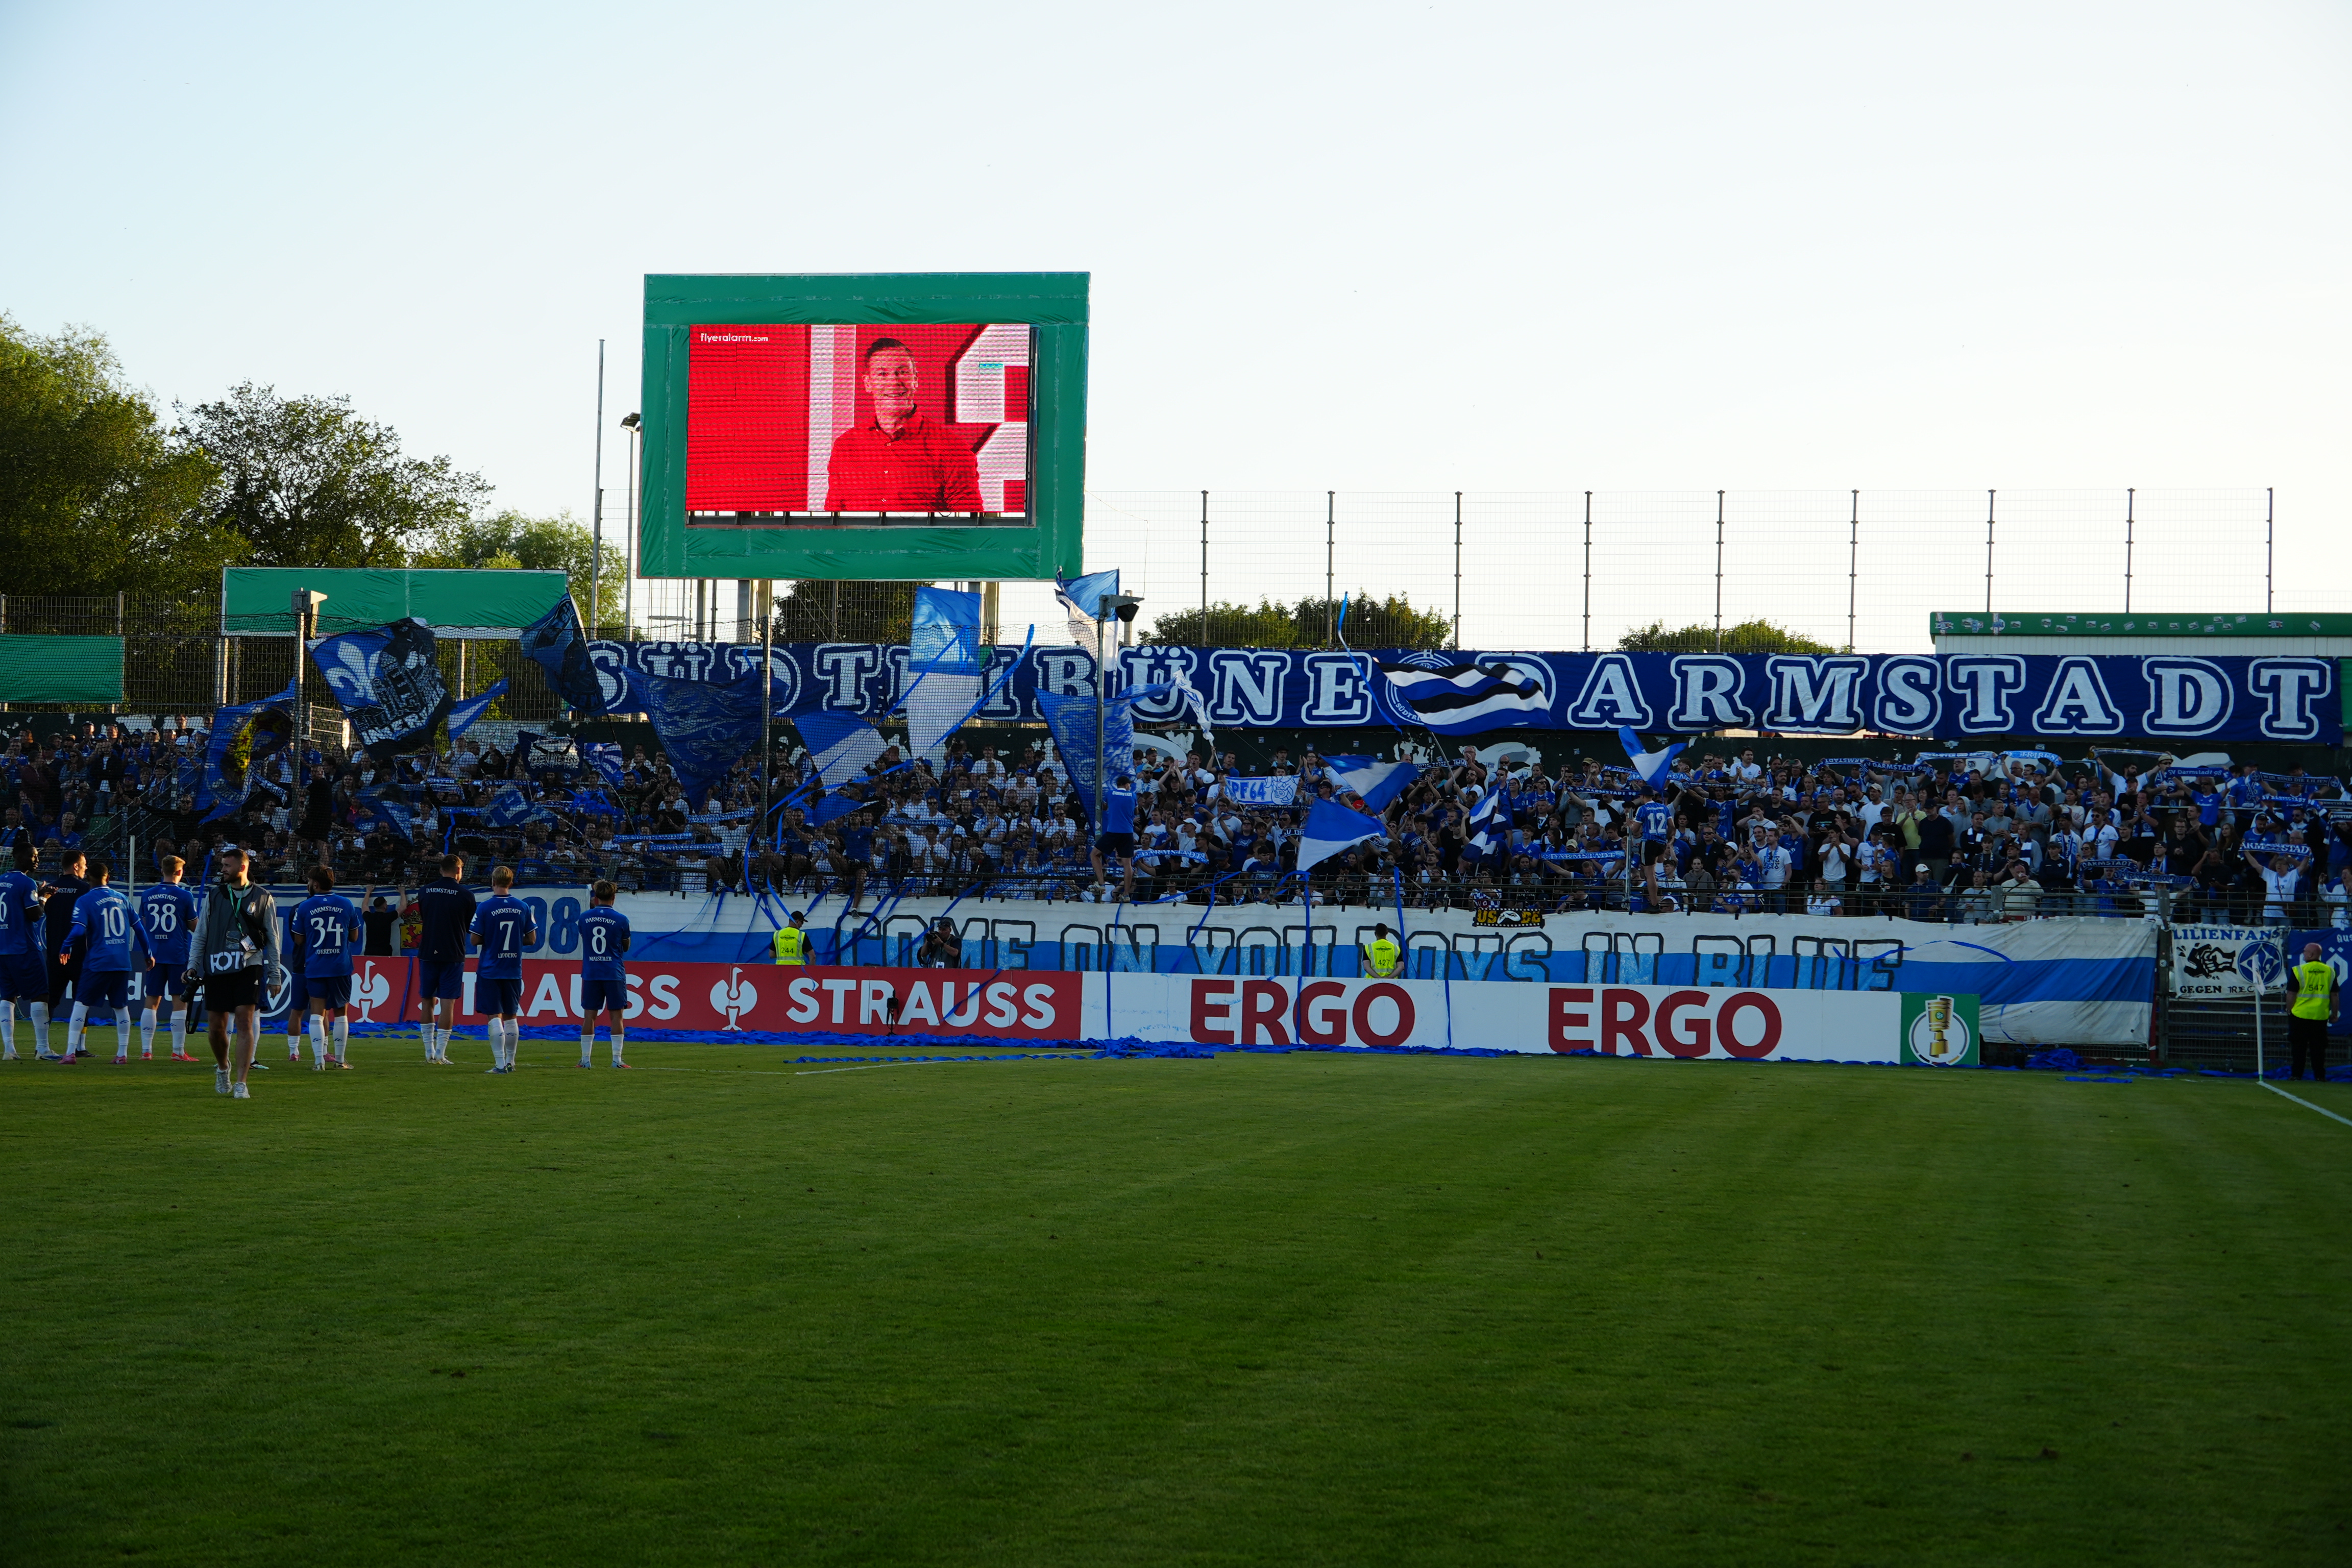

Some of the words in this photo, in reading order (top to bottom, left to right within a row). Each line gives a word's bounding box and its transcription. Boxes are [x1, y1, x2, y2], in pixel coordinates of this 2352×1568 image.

[700, 333, 769, 343] flyeralarm.com
[1872, 763, 1916, 772] DARMSTADT
[1586, 788, 1625, 796] DARMSTADT
[1647, 812, 1668, 835] 12
[1140, 848, 1205, 862] DARMSTADT
[1551, 851, 1615, 861] DARMSTADT
[148, 894, 178, 902] DARMSTADT
[426, 887, 458, 896] DARMSTADT
[309, 905, 344, 917] DARMSTADT
[491, 907, 523, 917] DARMSTADT
[1477, 909, 1498, 923] US
[100, 904, 122, 938] 10
[147, 903, 177, 933] 38
[584, 916, 617, 926] DARMSTADT
[310, 916, 345, 948] 34
[499, 920, 515, 951] 7
[2173, 928, 2280, 941] LILIENFANS
[591, 925, 607, 955] 8
[1060, 923, 1160, 972] ON
[1186, 925, 1337, 977] YOU
[1582, 932, 1664, 986] IN
[1693, 934, 1904, 991] BLUE
[2180, 986, 2222, 994] GEGEN
[2308, 984, 2324, 992] 547
[786, 977, 1056, 1030] STRAUSS
[1190, 978, 1415, 1048] ERGO
[1548, 988, 1782, 1060] ERGO
